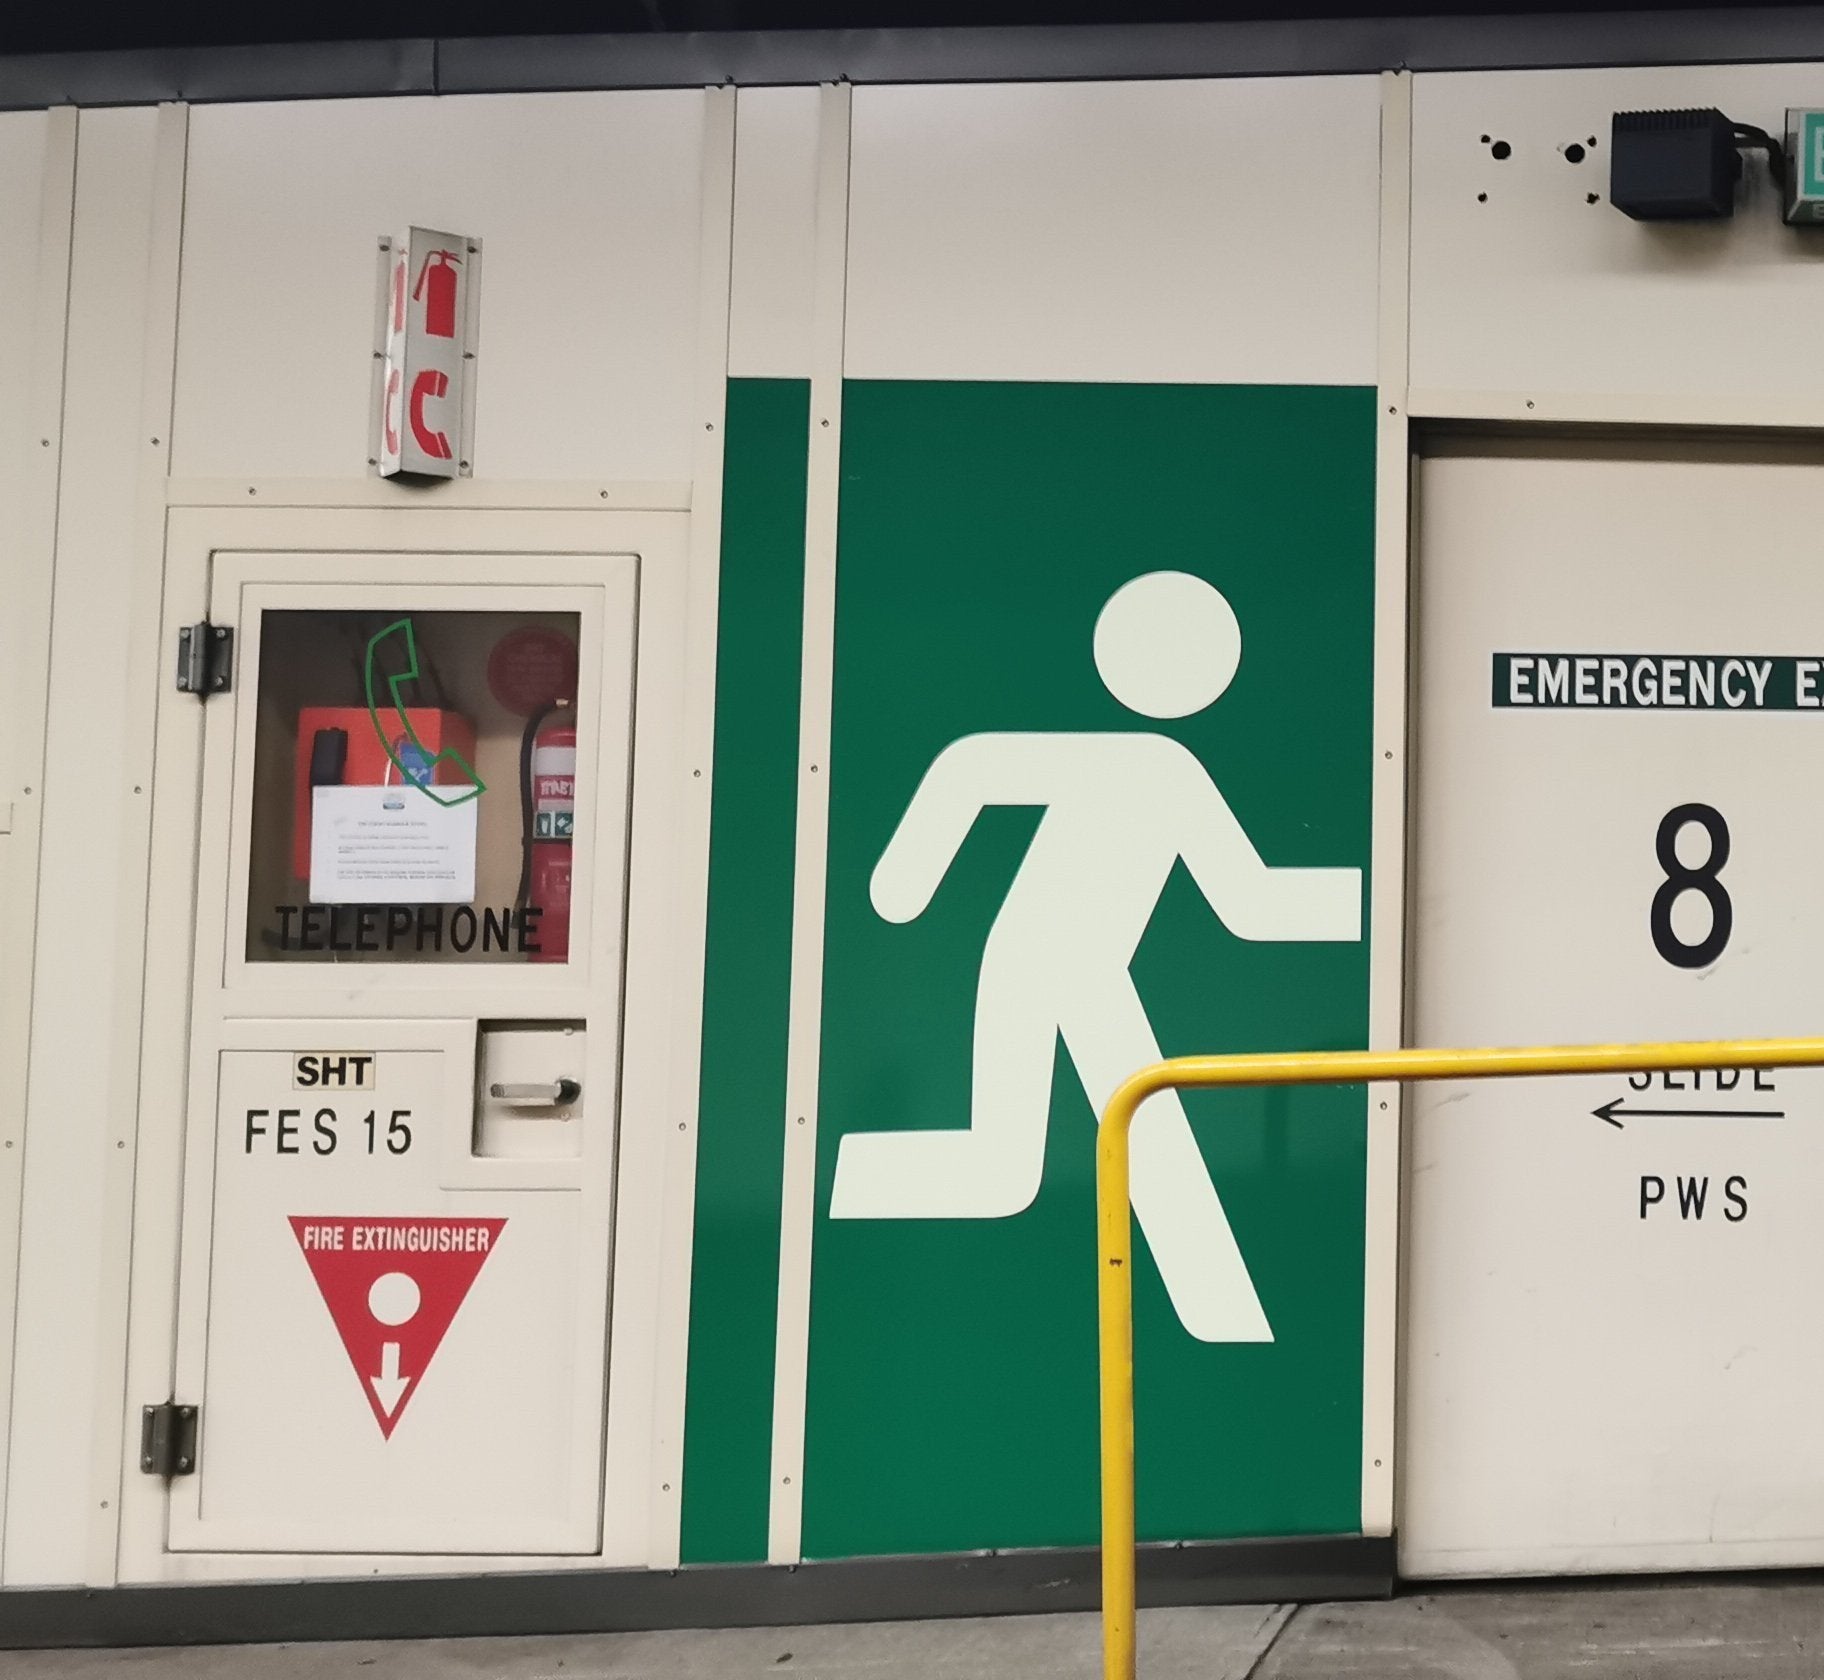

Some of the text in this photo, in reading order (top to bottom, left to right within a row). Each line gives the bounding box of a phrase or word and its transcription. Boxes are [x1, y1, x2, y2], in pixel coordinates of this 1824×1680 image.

[1509, 656, 1773, 707] EMERGENCY
[1650, 803, 1733, 969] 8
[275, 905, 544, 953] TELEPHONE
[296, 1056, 372, 1086] SHT
[245, 1108, 412, 1156] FES 15
[1640, 1175, 1748, 1222] PWS
[303, 1225, 490, 1253] FIRE EXTINGUISHER
